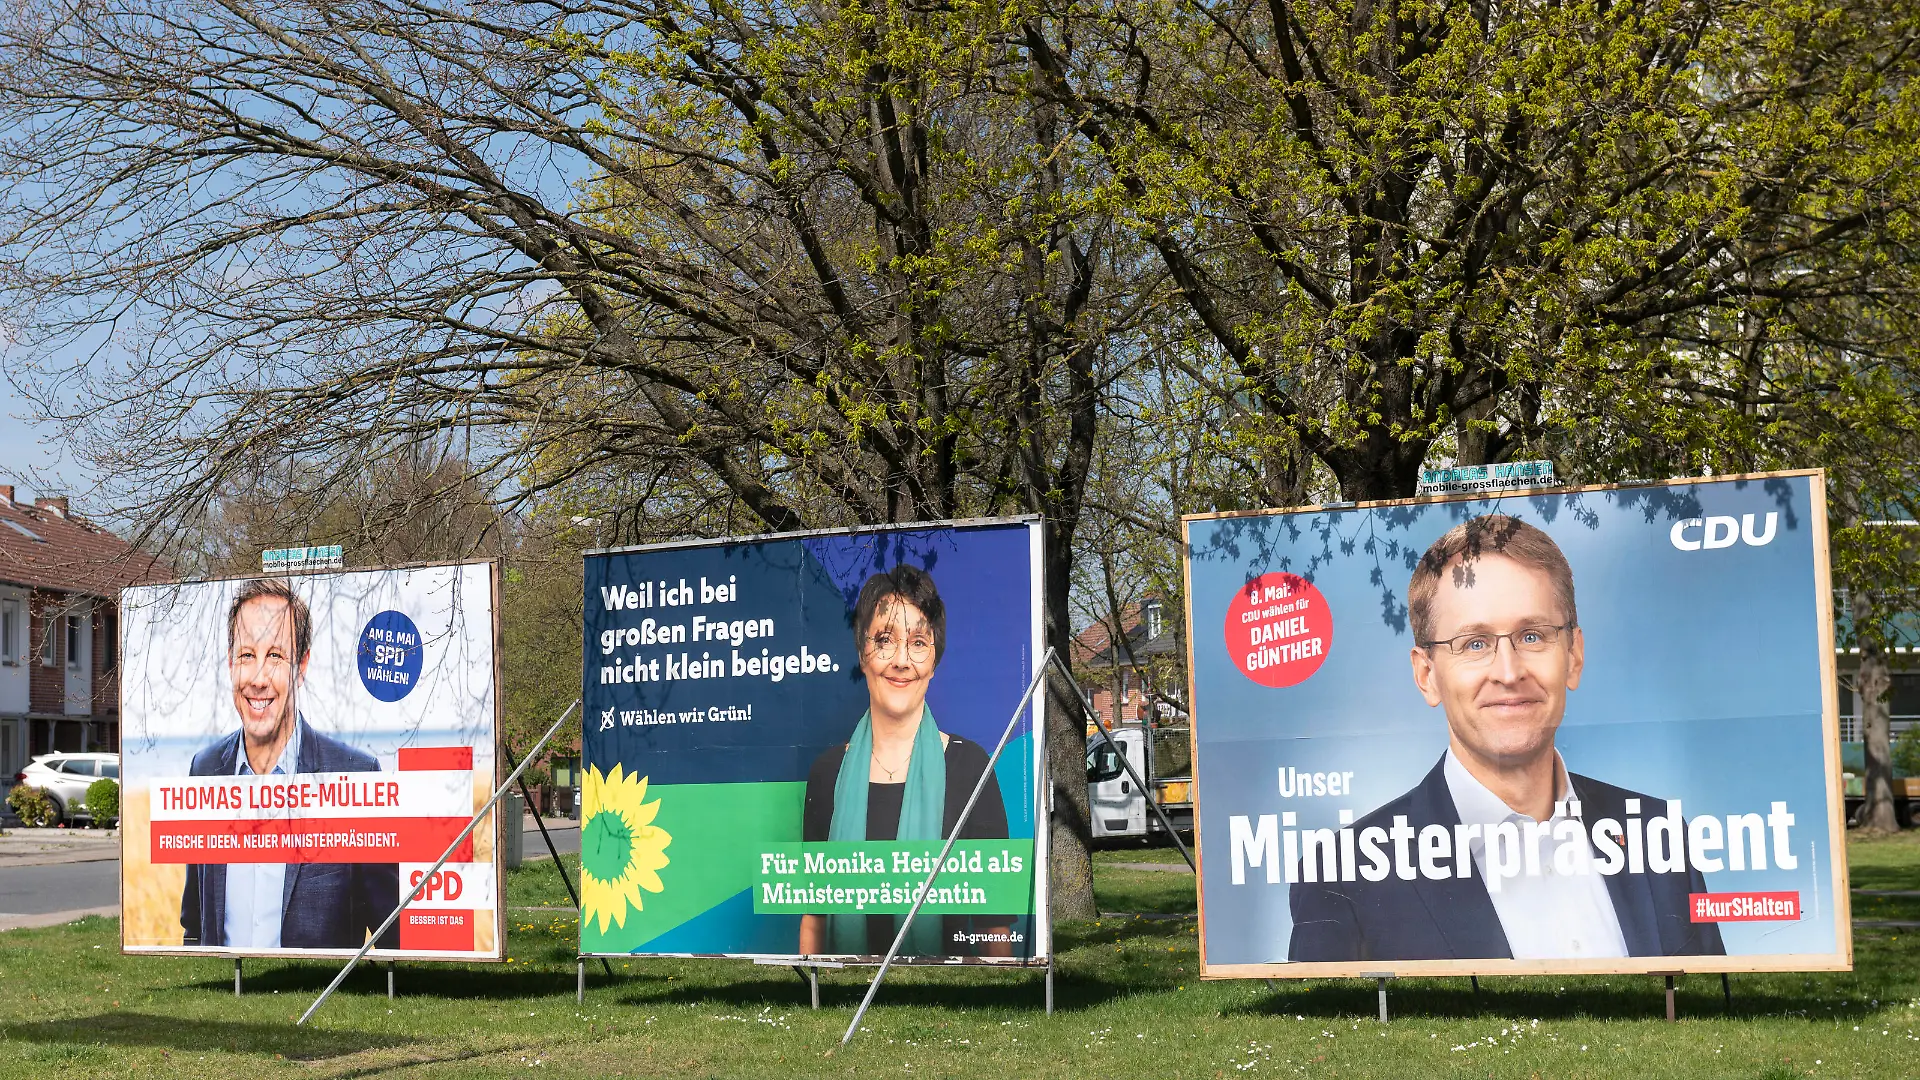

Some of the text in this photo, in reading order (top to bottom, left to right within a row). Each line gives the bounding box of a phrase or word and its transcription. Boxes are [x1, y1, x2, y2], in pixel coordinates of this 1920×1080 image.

[1422, 466, 1488, 483] ANDREAS
[1423, 475, 1553, 493] mobile-grossflaechen.de
[1670, 511, 1778, 551] CDU
[601, 575, 737, 611] Weil ich bei
[1250, 583, 1291, 606] 8. Mai:
[1241, 598, 1310, 624] CDU wählen für
[368, 627, 415, 646] AM 8. MAI
[601, 616, 774, 655] großen Fragen
[1250, 615, 1310, 646] DANIEL
[374, 644, 405, 667] SPD
[601, 645, 840, 684] nicht klein beigebe.
[1246, 637, 1323, 672] GÜNTHER
[367, 665, 410, 685] WÄHLEN!
[620, 704, 752, 727] Wählen wir Grün!
[160, 775, 400, 810] THOMAS LOSSE-MÜLLER
[1278, 766, 1354, 798] Unser
[159, 828, 400, 849] FRISCHE IDEEN. NEUER MINISTERPRÄSIDENT.
[1228, 798, 1798, 893] Ministerpräsident
[761, 853, 799, 875] Für
[803, 852, 886, 874] Monika
[987, 850, 1023, 873] als
[409, 869, 463, 902] SPD
[409, 915, 464, 925] BESSER IST DAS
[1695, 898, 1796, 921] #kurSHalten
[953, 930, 1024, 945] sh-gruene.de
